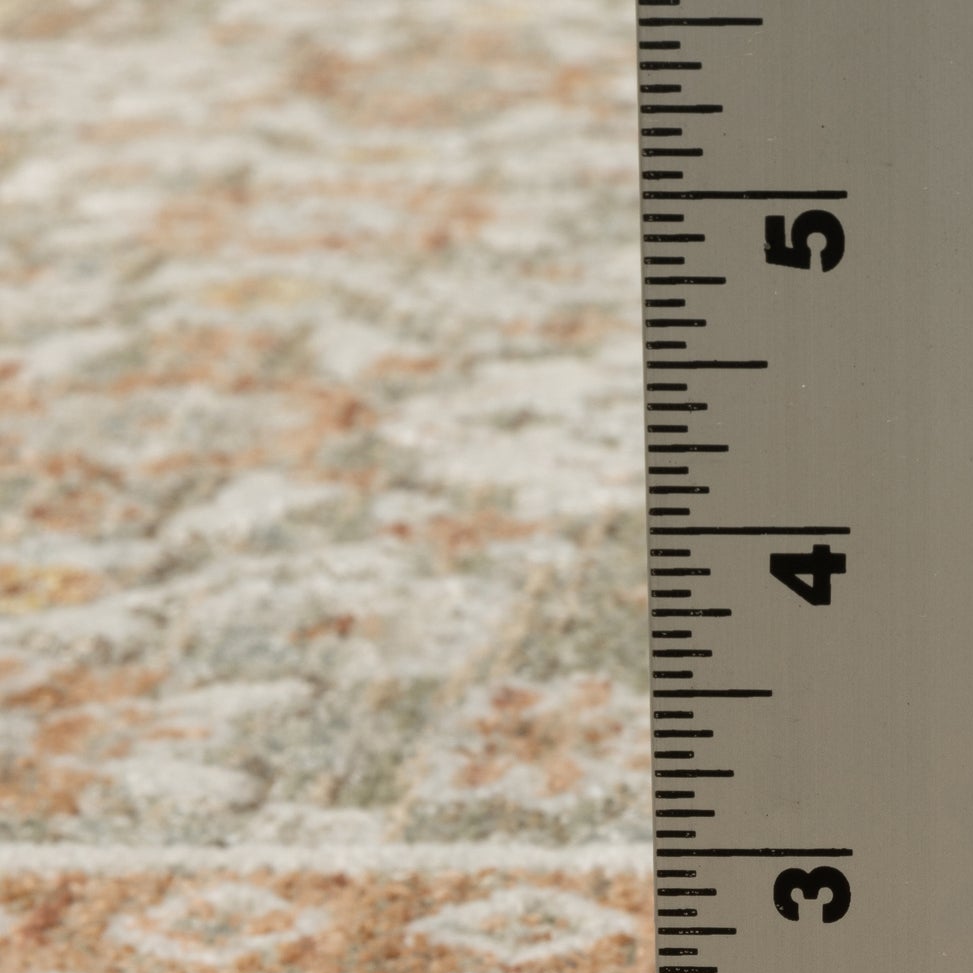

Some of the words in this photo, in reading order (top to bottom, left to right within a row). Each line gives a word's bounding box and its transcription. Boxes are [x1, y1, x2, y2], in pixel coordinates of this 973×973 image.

[763, 209, 846, 273] 5
[769, 543, 847, 607] 4
[773, 865, 852, 924] 3
